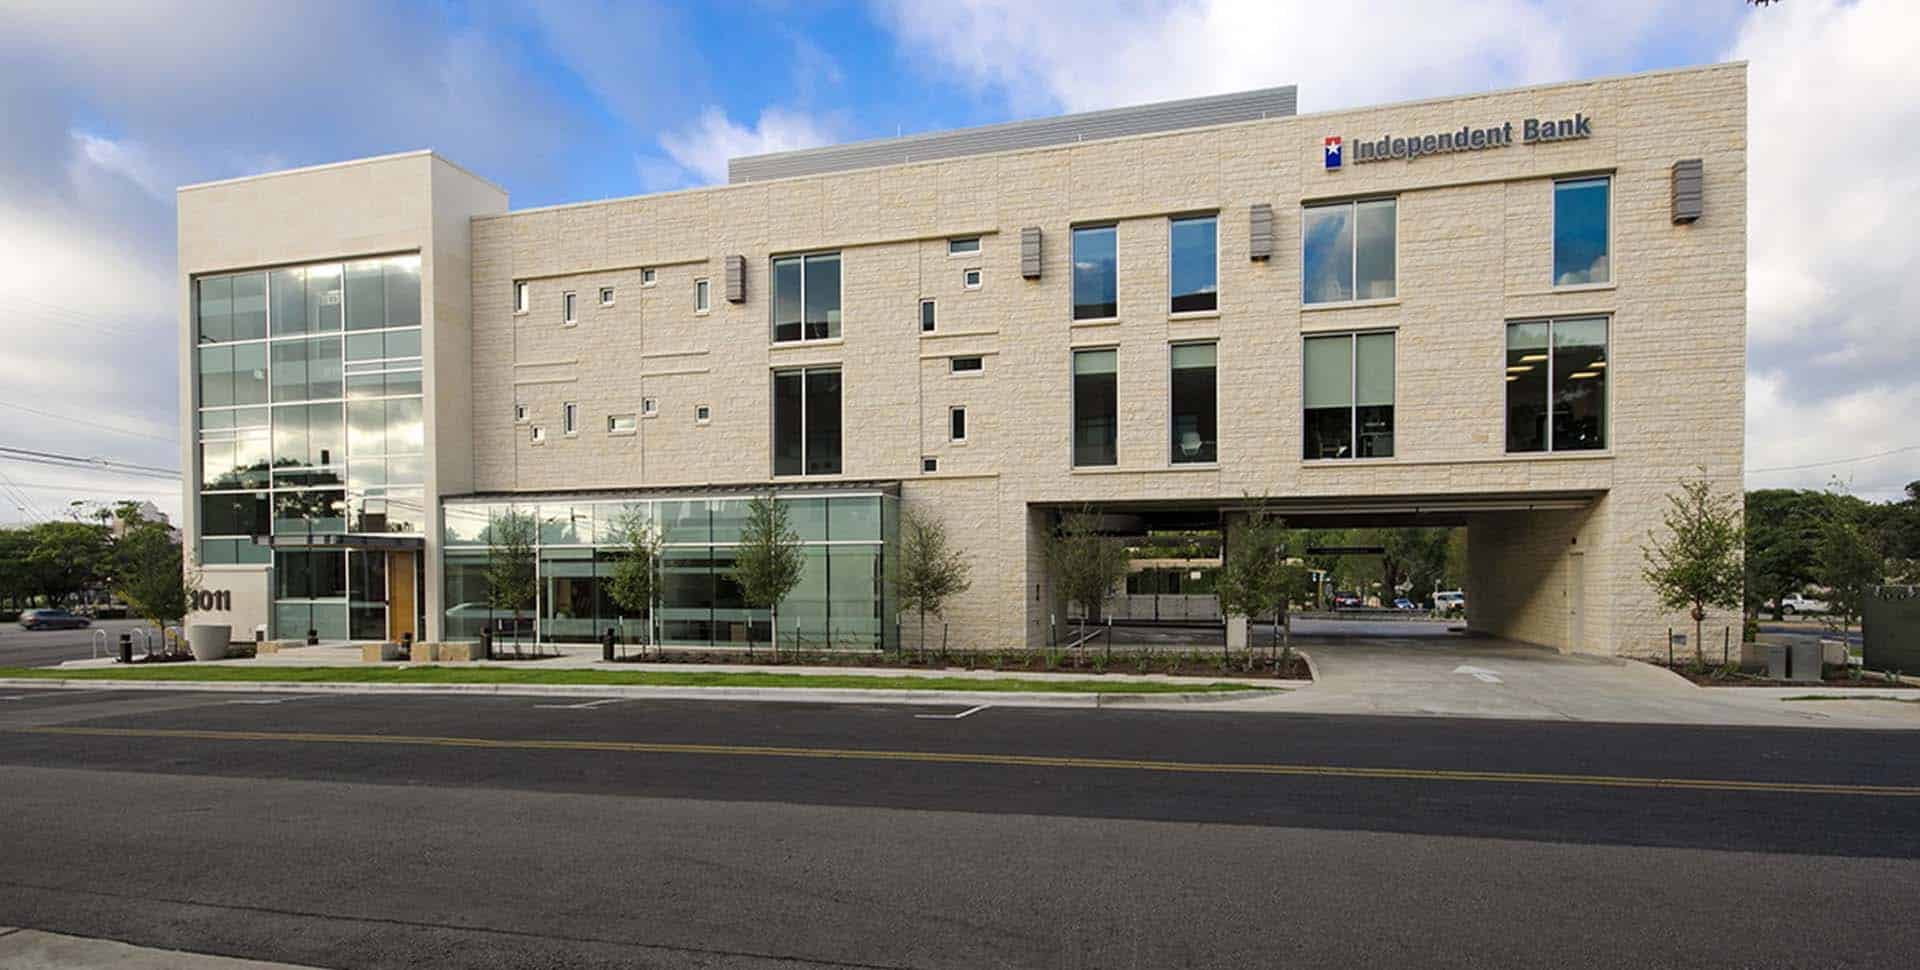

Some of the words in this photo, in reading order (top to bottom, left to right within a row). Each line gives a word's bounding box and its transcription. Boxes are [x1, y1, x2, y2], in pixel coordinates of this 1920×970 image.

[1353, 121, 1513, 162] Independent
[1523, 113, 1592, 143] Bank
[190, 589, 232, 612] 1011
